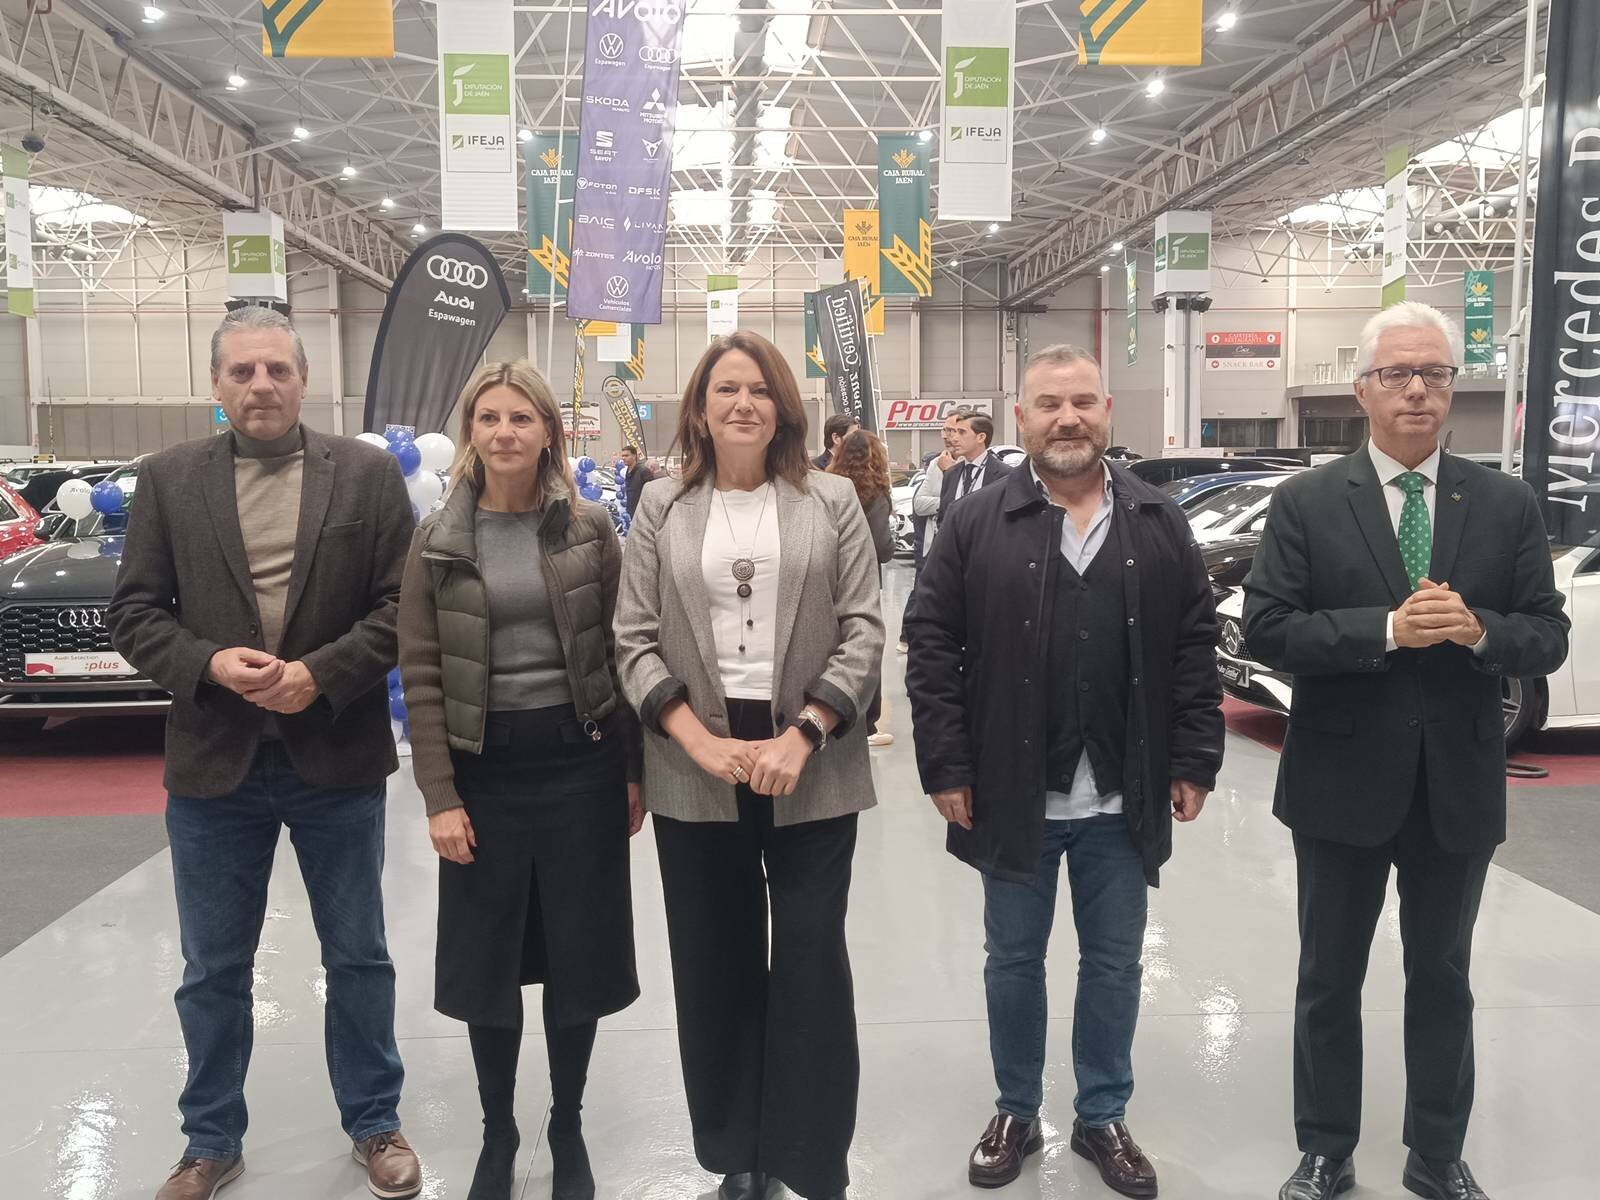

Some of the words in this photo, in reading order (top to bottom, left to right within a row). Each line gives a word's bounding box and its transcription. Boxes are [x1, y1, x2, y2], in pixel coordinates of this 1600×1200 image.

[966, 127, 1001, 137] IFEJA
[468, 135, 505, 146] IFEJA
[883, 169, 900, 177] CAJA
[901, 169, 926, 177] RURAL
[578, 214, 616, 227] BAIC
[433, 290, 475, 310] Audi
[428, 308, 476, 326] Espawagen
[639, 405, 648, 418] 5
